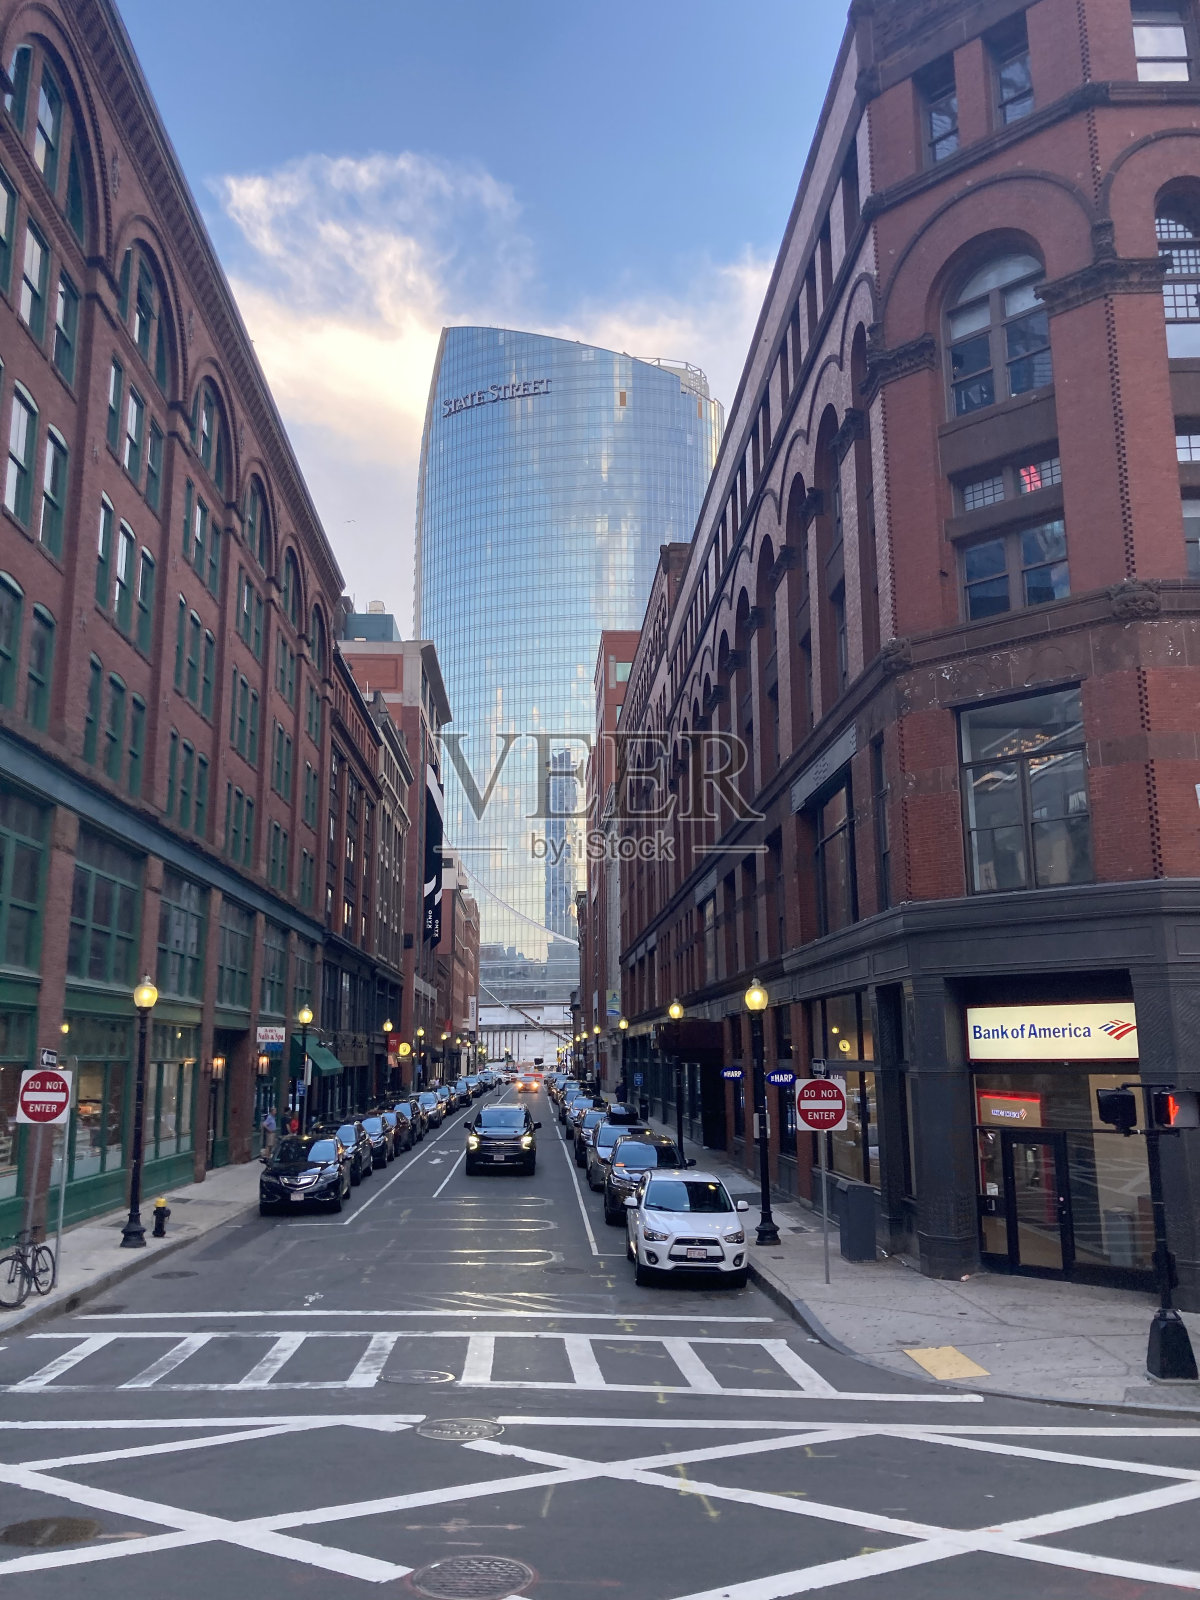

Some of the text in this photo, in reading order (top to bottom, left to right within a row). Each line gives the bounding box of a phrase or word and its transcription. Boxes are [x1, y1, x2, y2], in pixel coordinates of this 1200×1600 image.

[442, 379, 552, 418] STATE STREET
[972, 1022, 1092, 1040] Bank of America
[774, 1074, 793, 1083] HARP
[28, 1081, 64, 1090] DO NOT
[803, 1089, 838, 1098] DO NOT
[29, 1103, 58, 1113] ENTER
[807, 1111, 836, 1120] ENTER
